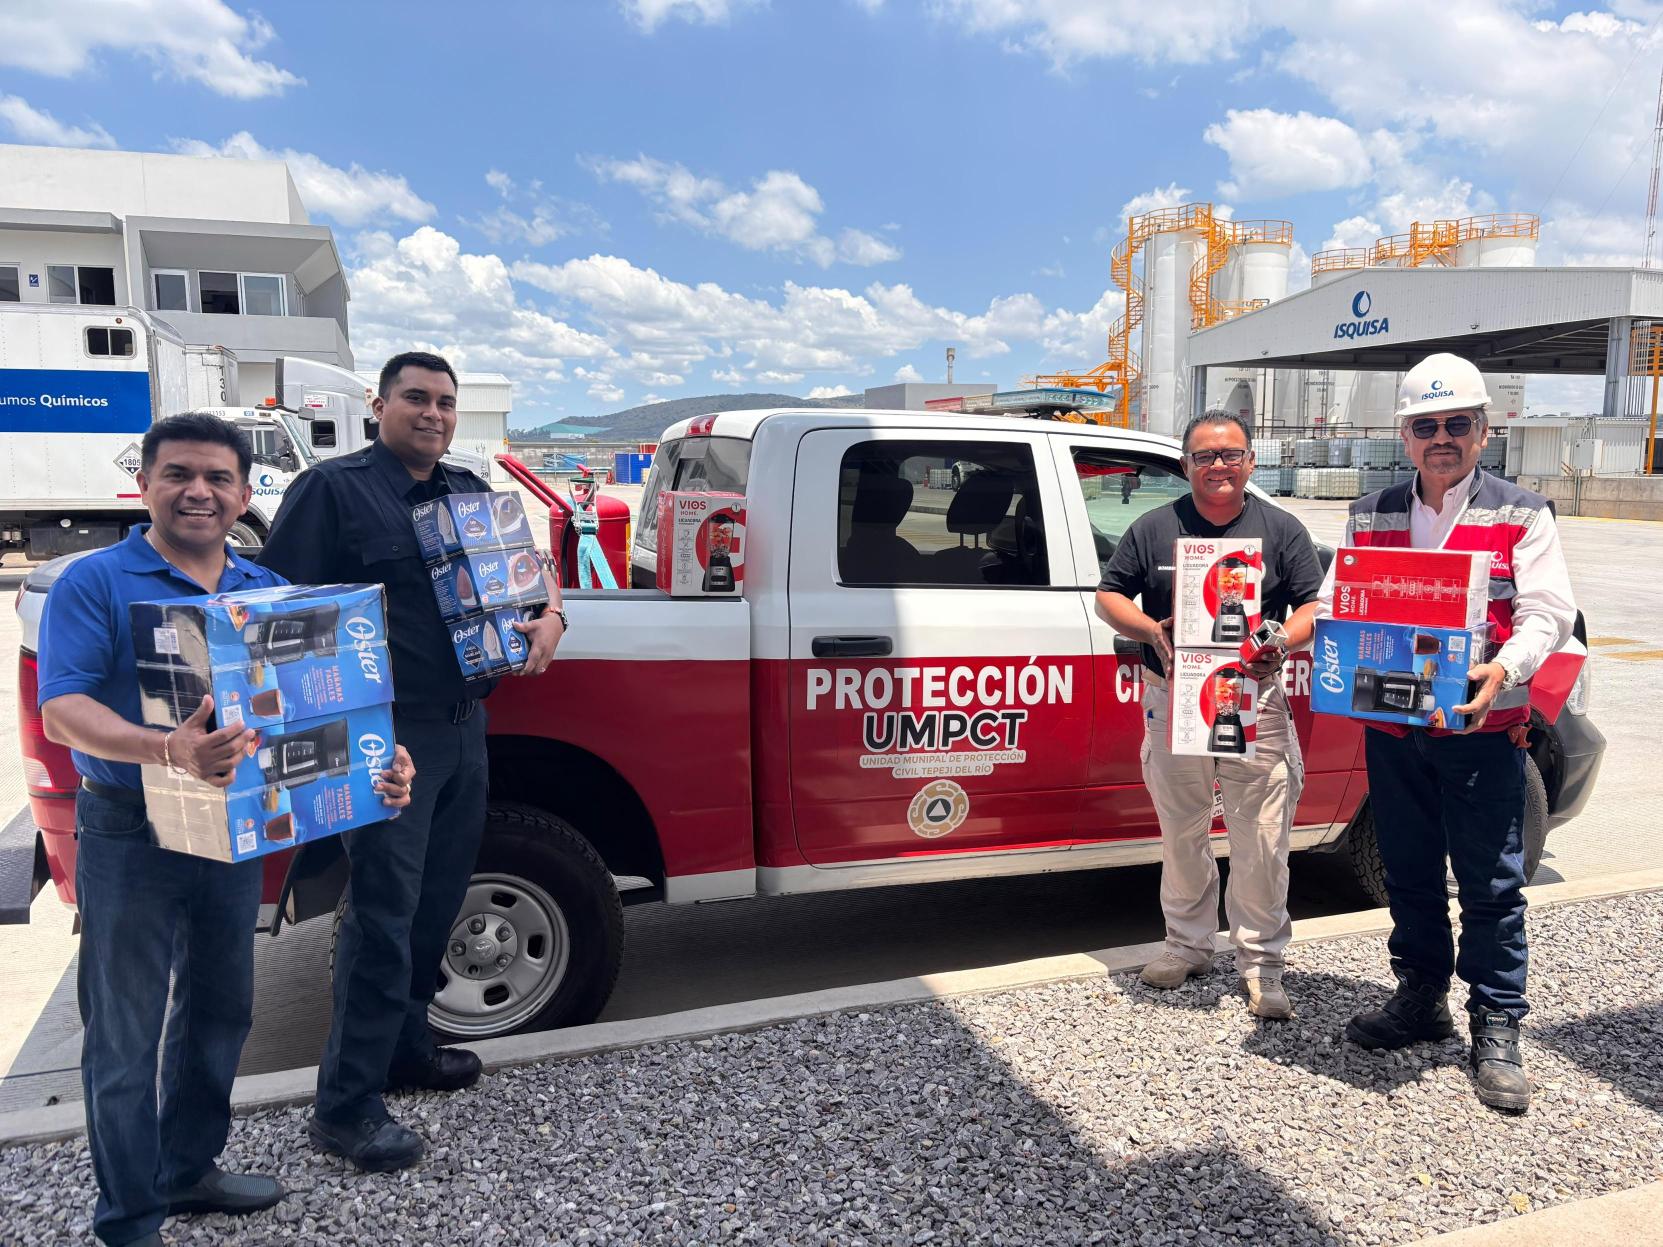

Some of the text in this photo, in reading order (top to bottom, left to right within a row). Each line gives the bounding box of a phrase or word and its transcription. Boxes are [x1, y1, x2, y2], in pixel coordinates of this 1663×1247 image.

[1334, 317, 1389, 340] ISQUISA
[0, 394, 109, 408] umos Químicos
[1421, 389, 1454, 401] ISQUISA
[123, 458, 141, 467] 1805
[412, 502, 434, 522] Oster
[457, 500, 480, 518] Oster
[679, 500, 707, 510] VIOS
[1183, 544, 1215, 554] VIOS
[431, 562, 452, 581] Oster
[479, 560, 499, 579] Oster
[1339, 585, 1351, 614] VIOS
[453, 624, 480, 644] Oster
[345, 616, 382, 684] Oster
[1181, 653, 1212, 664] VIOS
[1319, 635, 1345, 694] Oster
[806, 656, 1147, 710] PROTECCIÓN CI
[864, 710, 1028, 752] UMPCT
[862, 750, 1024, 766] UNIDAD MUNIPAL DE PROTECCIÓN
[895, 763, 992, 777] CIVIL TEPEJI DEL RÍO
